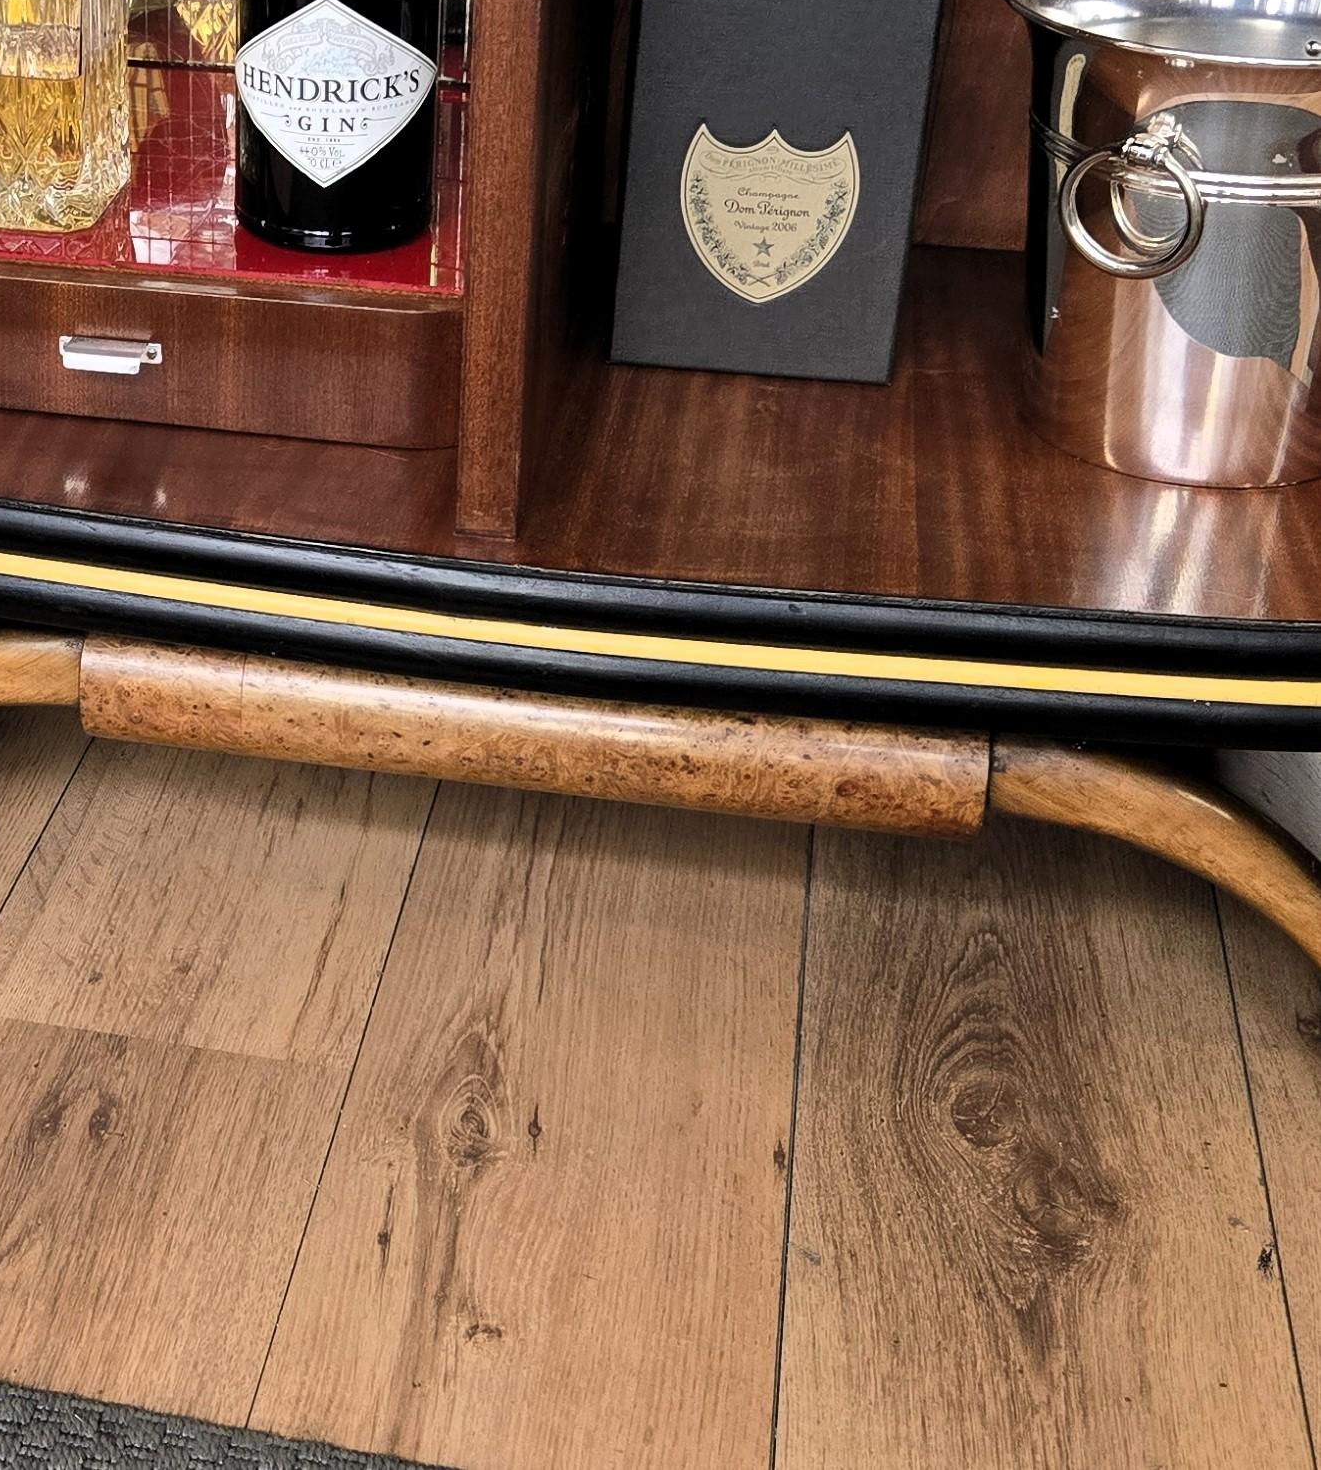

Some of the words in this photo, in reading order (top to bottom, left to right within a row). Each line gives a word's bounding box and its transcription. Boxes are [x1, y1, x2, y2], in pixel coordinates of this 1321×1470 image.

[243, 62, 421, 104] HENDRICK'S
[297, 115, 356, 133] GIN
[737, 186, 800, 202] Champagne
[724, 198, 757, 214] Dom
[757, 200, 811, 221] Pérignon
[733, 220, 771, 234] Vintage
